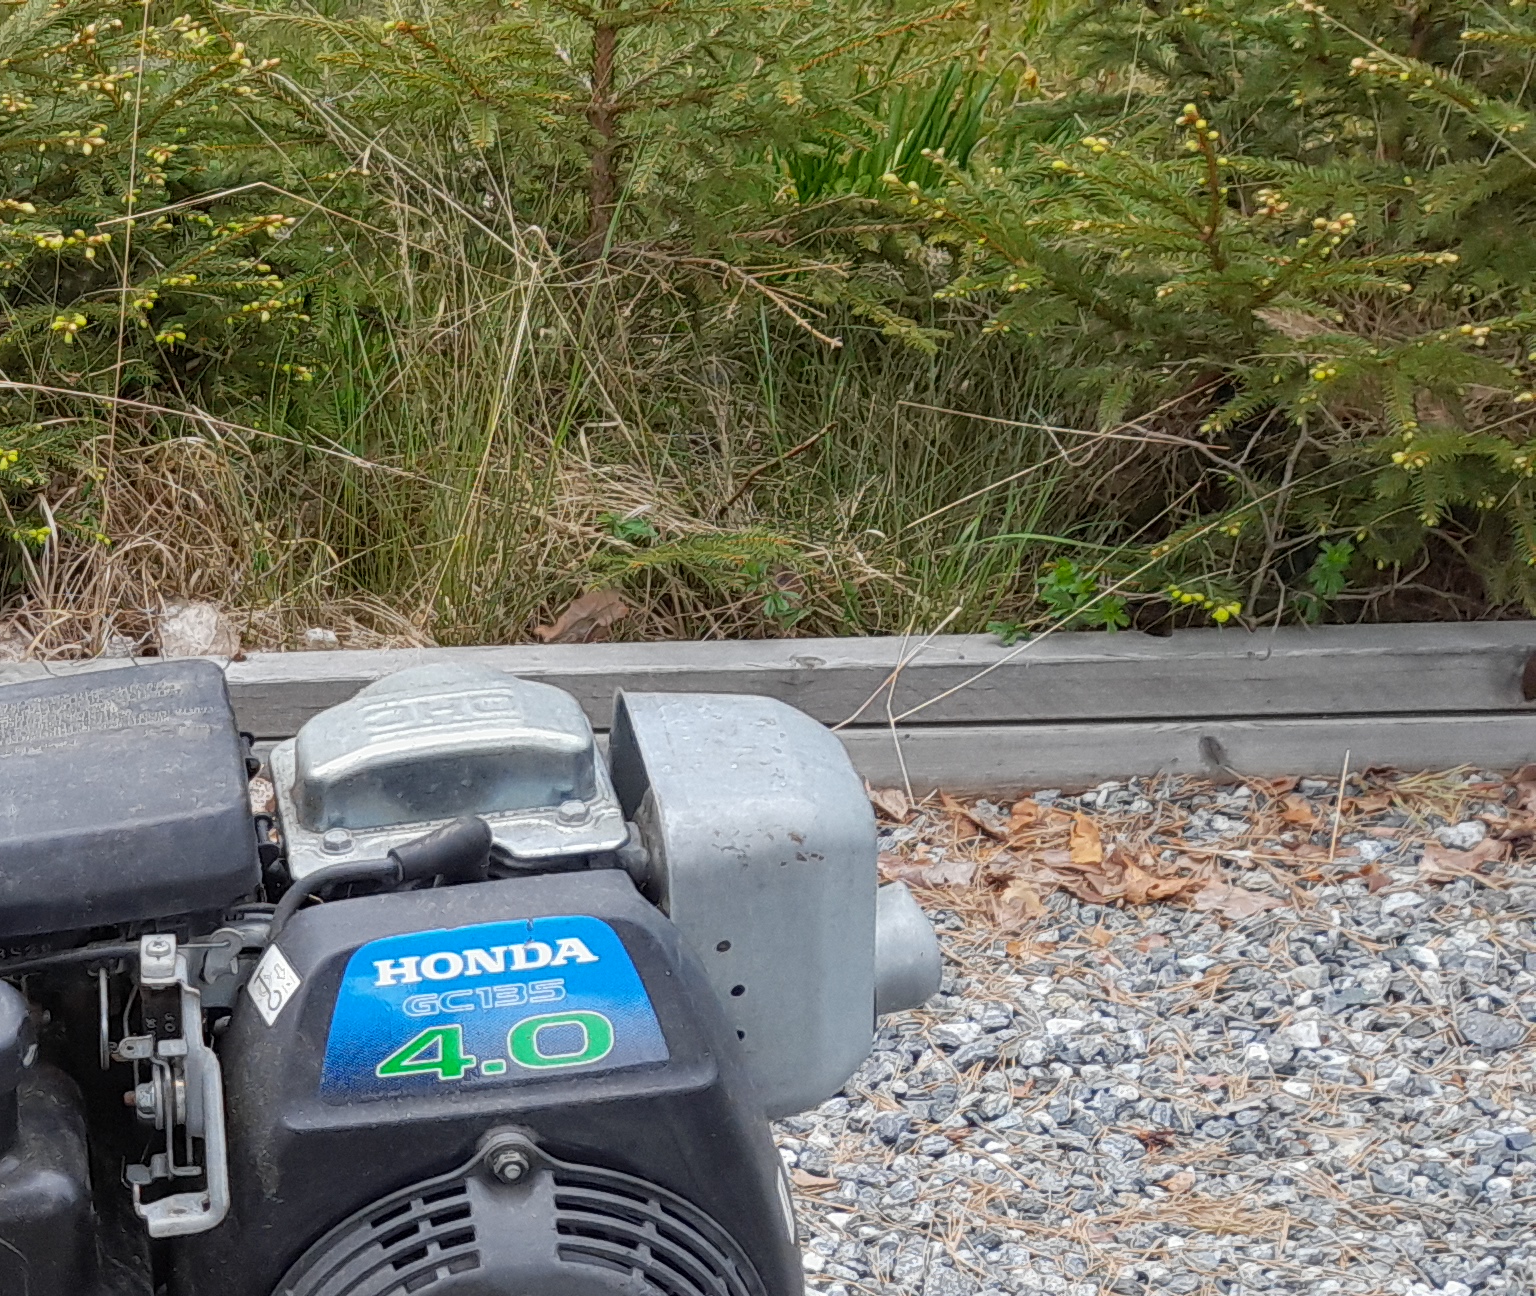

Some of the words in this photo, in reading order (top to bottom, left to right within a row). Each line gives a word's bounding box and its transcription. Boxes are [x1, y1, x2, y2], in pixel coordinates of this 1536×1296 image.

[374, 938, 598, 987] HONDA
[404, 978, 565, 1017] GC135
[375, 1010, 613, 1080] 4.0
